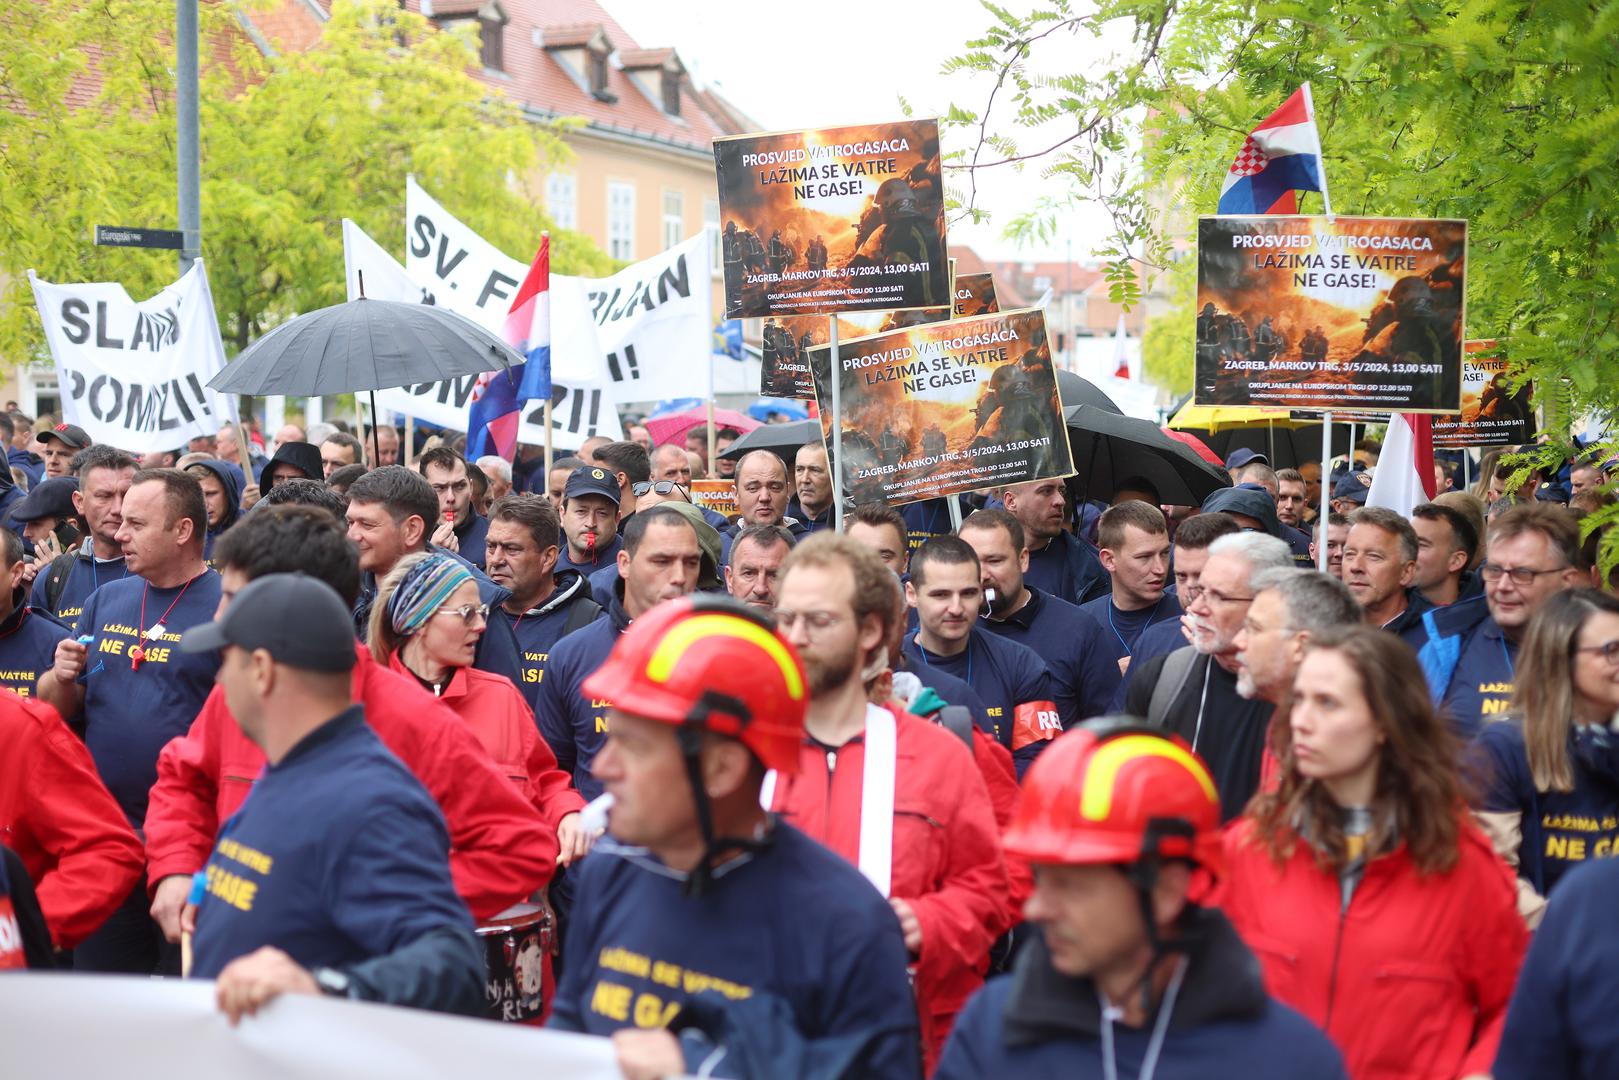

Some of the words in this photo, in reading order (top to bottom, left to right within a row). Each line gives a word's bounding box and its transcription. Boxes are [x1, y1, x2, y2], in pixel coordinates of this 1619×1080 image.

[742, 148, 806, 167] PROSVJED
[807, 138, 909, 161] VATROGASACA
[760, 166, 819, 185] LAŽIMA
[821, 164, 839, 179] SE
[842, 158, 897, 177] VATRE
[794, 184, 815, 200] NE
[818, 180, 863, 198] GASE!
[411, 214, 469, 289] SV.
[1232, 234, 1312, 248] PROSVJED
[1314, 233, 1433, 250] VATROGASACA
[1253, 250, 1326, 269] LAŽIMA
[1330, 254, 1351, 269] SE
[1356, 255, 1417, 270] VATRE
[747, 273, 781, 284] ZAGREB,
[782, 269, 820, 281] MARKOV
[821, 269, 839, 279] TRG,
[840, 265, 883, 276] 3/5/2024,
[884, 263, 908, 274] 13,00
[909, 262, 930, 272] SATI
[1294, 273, 1318, 287] NE
[1323, 273, 1376, 288] GASE!
[842, 347, 912, 371] PROSVJED
[913, 329, 1019, 355] VATROGASACA
[864, 361, 929, 385] LAŽIMA
[931, 356, 951, 371] SE
[953, 347, 1009, 368] VATRE
[1224, 361, 1269, 371] ZAGREB,
[1269, 361, 1316, 371] MARKOV
[1318, 362, 1340, 372] TRG,
[1343, 362, 1390, 373] 3/5/2024,
[1392, 363, 1418, 374] 13,00
[1420, 364, 1443, 374] SATI
[1471, 361, 1505, 371] VATRE
[903, 377, 926, 394] NE
[929, 368, 976, 389] GASE!
[1463, 373, 1484, 382] ASE!
[858, 464, 897, 478] ZAGREB,
[898, 455, 939, 471] MARKOV
[940, 452, 961, 463] TRG,
[963, 444, 1005, 459] 3/5/2024,
[1006, 441, 1029, 452] 13,00
[1030, 437, 1050, 448] SATI
[931, 469, 969, 481] EUROPSKOM
[971, 466, 987, 474] TRGU
[103, 623, 138, 637] LAŽIMA
[99, 638, 124, 655] NE
[1545, 834, 1585, 860] NE
[591, 980, 633, 1022] NE
